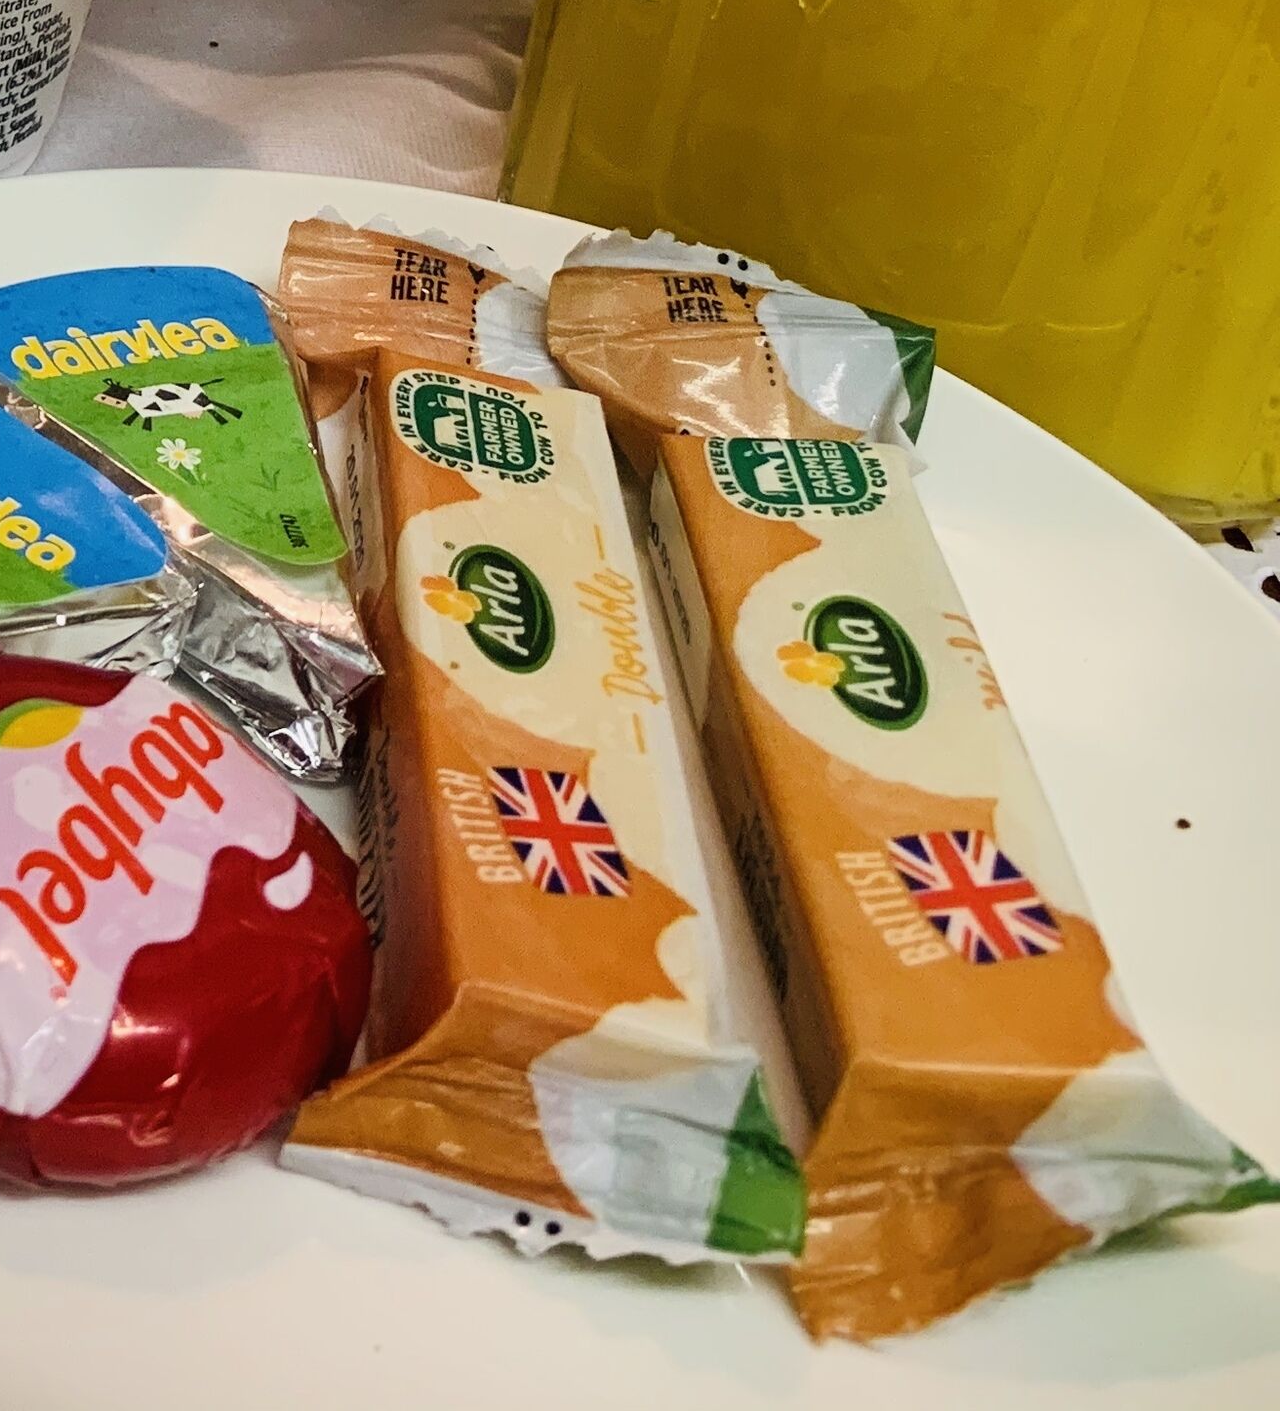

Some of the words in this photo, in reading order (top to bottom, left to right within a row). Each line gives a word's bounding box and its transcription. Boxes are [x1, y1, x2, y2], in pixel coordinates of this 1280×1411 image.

[20, 3, 52, 24] From
[394, 247, 448, 279] TEAR
[390, 274, 450, 305] HERE
[661, 275, 718, 297] TEAR
[667, 297, 728, 324] HERE
[10, 317, 241, 380] dairylea
[412, 372, 461, 386] STEP
[396, 377, 415, 420] EVERY
[399, 422, 417, 438] IN
[478, 400, 505, 464] FARMER
[499, 407, 525, 466] OWNED
[529, 411, 549, 430] TO
[413, 442, 473, 473] CARE
[537, 434, 555, 466] COW
[708, 437, 729, 476] EVER
[498, 466, 552, 484] FROM
[795, 440, 835, 497] FARMER
[818, 441, 856, 496] OWNED
[719, 481, 741, 496] IN
[831, 492, 886, 517] FROM
[863, 457, 888, 488] COW
[738, 497, 805, 518] CARE
[477, 563, 530, 656] Arla
[826, 617, 906, 709] Arla
[436, 767, 524, 884] BRITISH
[835, 851, 951, 967] BRITISH
